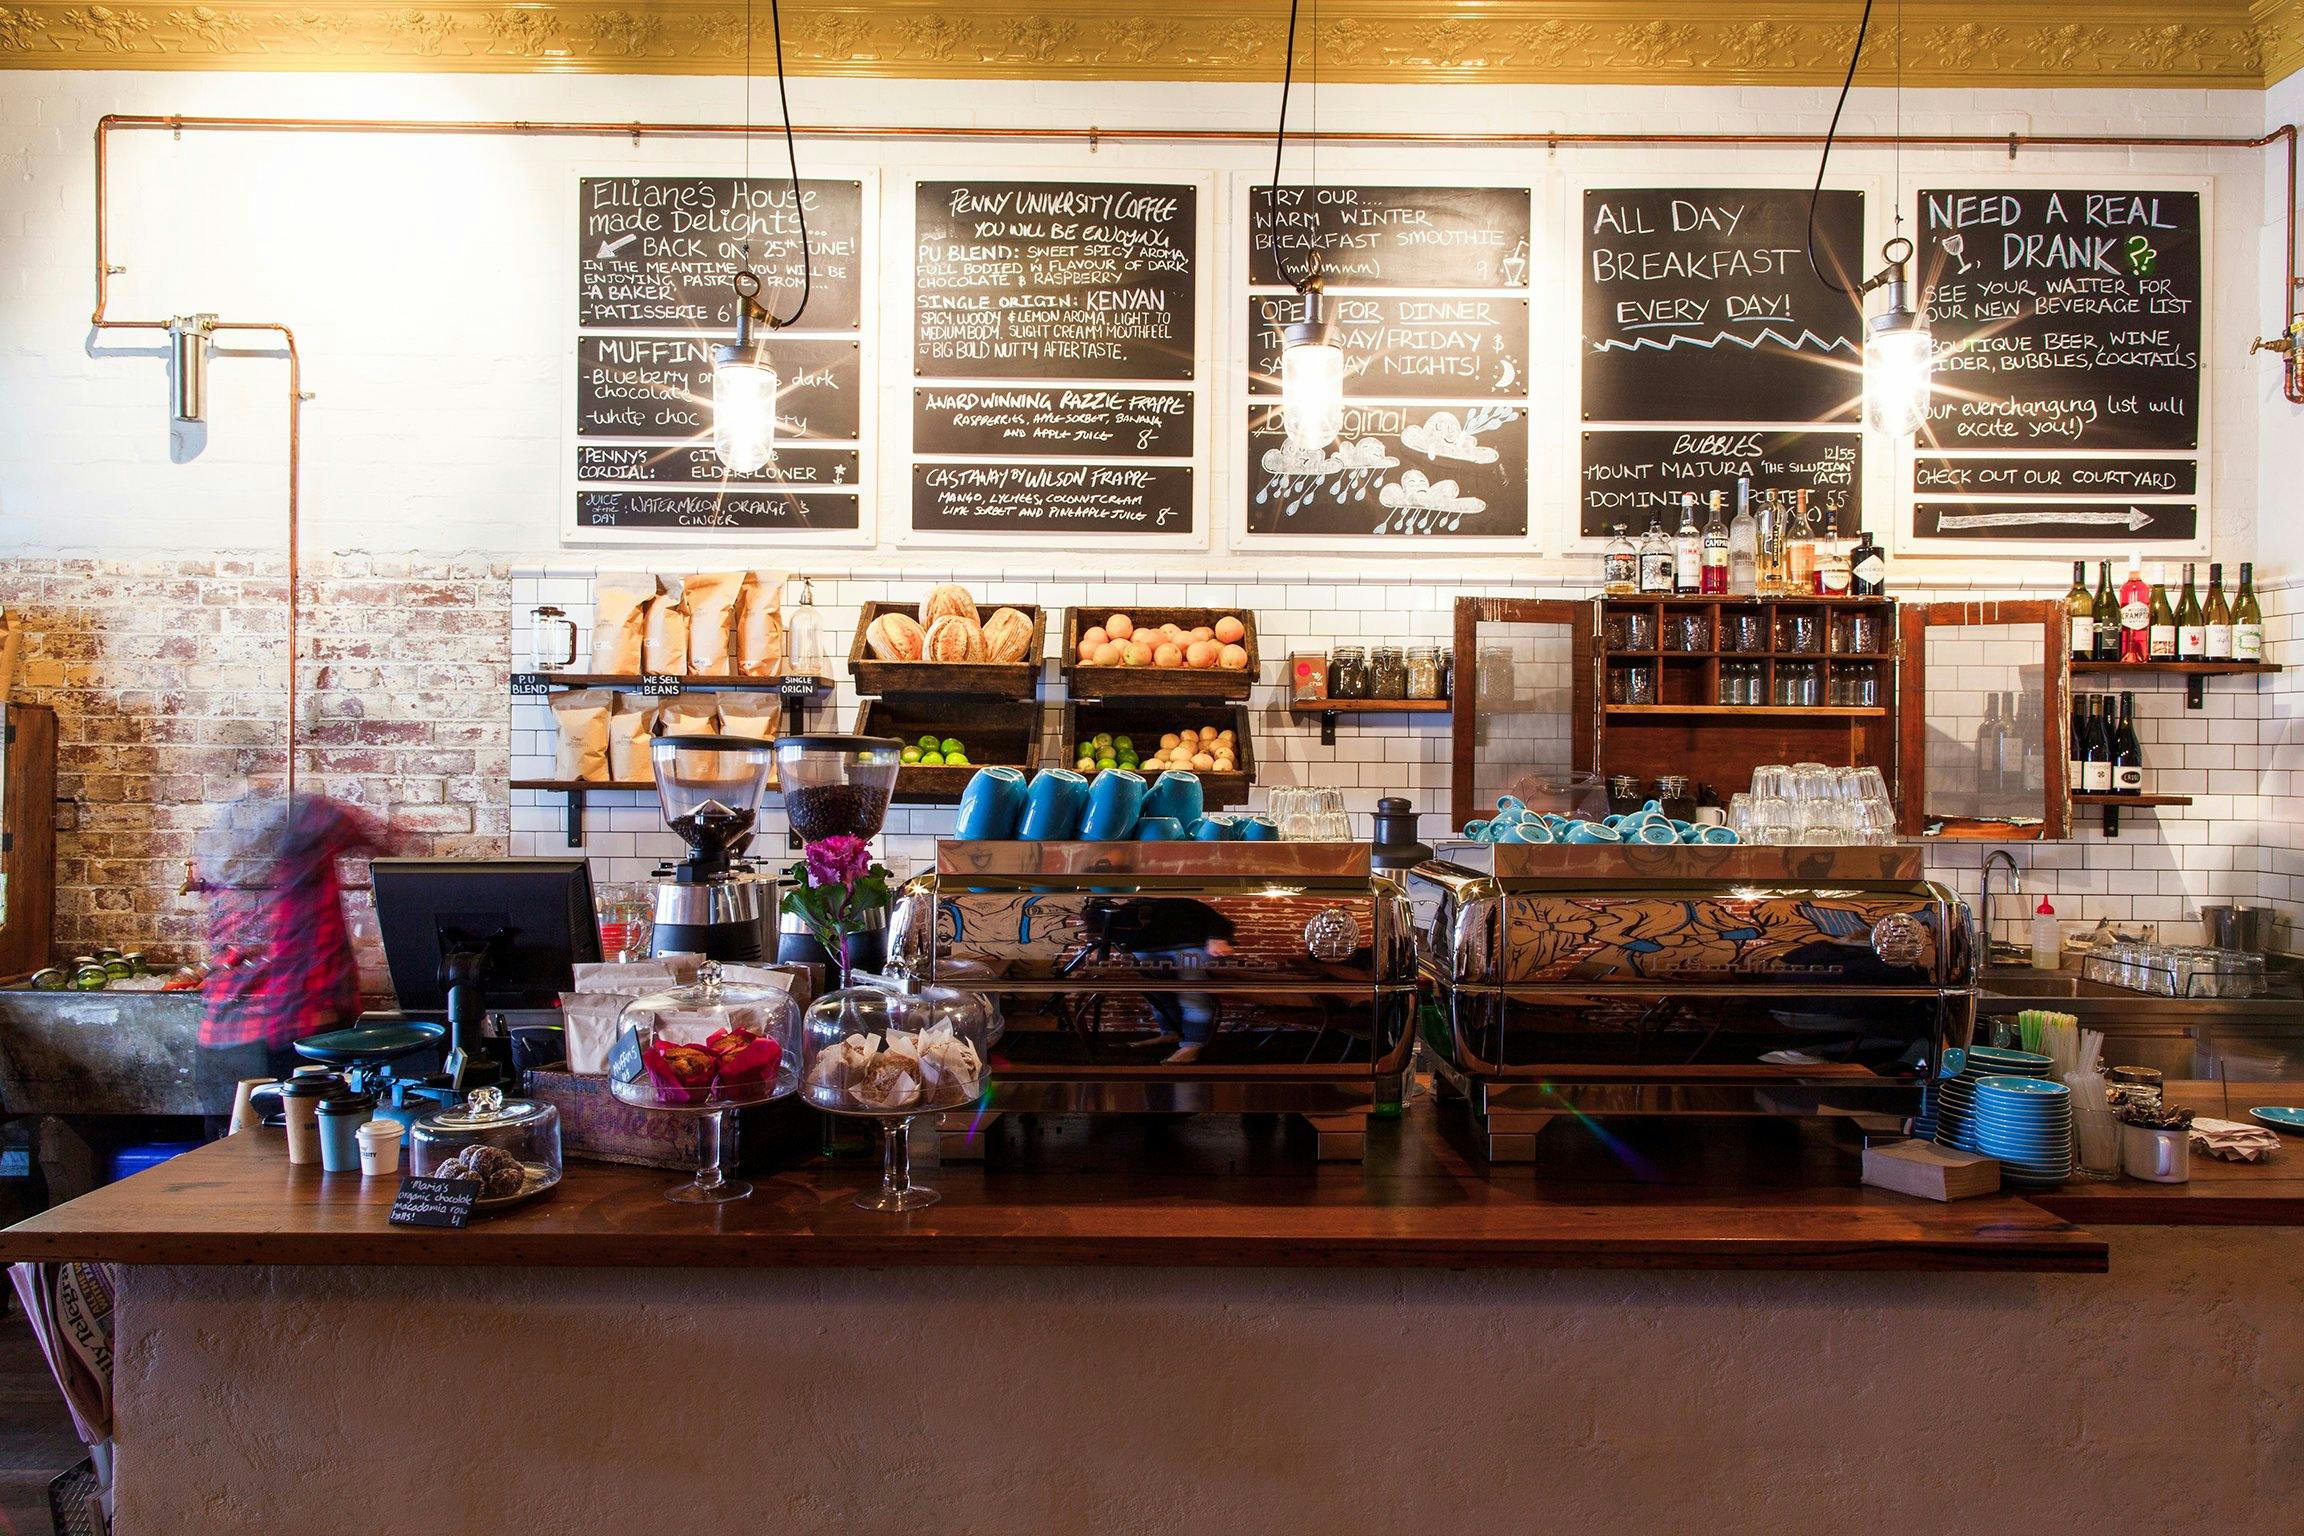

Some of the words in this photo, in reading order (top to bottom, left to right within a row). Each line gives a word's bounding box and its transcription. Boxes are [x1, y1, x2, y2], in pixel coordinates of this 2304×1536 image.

[593, 180, 715, 211] Elliane's
[732, 181, 820, 211] House
[1261, 189, 1305, 207] TRY
[950, 188, 1014, 218] PENNY
[1016, 191, 1113, 219] UNIVERSITY
[1115, 191, 1177, 223] COFFEE
[1928, 195, 2021, 229] NEED
[2046, 192, 2068, 225] A
[2086, 194, 2178, 229] REAL
[589, 210, 662, 236] made
[1255, 212, 1321, 229] WARM
[1340, 209, 1433, 227] WINTER
[1594, 203, 1655, 235] ALL
[1672, 200, 1745, 237] DAY
[974, 221, 1005, 239] YOU
[1009, 222, 1045, 238] WILL
[1050, 223, 1079, 240] BE
[1083, 226, 1170, 249] ENJOYING
[1255, 233, 1382, 250] BREAKFAST
[1396, 229, 1506, 246] SMOOTHIE
[643, 236, 708, 258] BACK
[919, 245, 941, 263] PU
[949, 245, 1020, 262] BLEND:
[1027, 246, 1078, 257] SWEET
[1084, 245, 1134, 258] SPICY
[2004, 233, 2121, 275] DRANK
[583, 259, 603, 271] IN
[609, 260, 638, 273] THE
[646, 261, 737, 274] MEANTIME
[749, 263, 777, 277] YOU
[828, 266, 847, 278] BE
[917, 263, 958, 277] FULL
[963, 262, 1023, 275] BODIED
[1049, 260, 1116, 273] FLAVOUR
[1124, 260, 1144, 271] OF
[1149, 260, 1189, 274] DARK
[1593, 249, 1801, 283] BREAKFAST
[584, 274, 675, 287] ENJOYING
[917, 275, 1010, 288] CHOCOLATE
[1034, 271, 1123, 285] RASPBERRY
[1925, 285, 1967, 303] SEE
[1977, 280, 2037, 297] YOUR
[2046, 277, 2130, 296] WAITER
[2139, 278, 2176, 298] FOR
[917, 295, 989, 310] SINGLE
[998, 293, 1079, 309] ORIGIN:
[1087, 288, 1165, 311] KENYAN
[1617, 298, 1710, 323] EVERY
[1726, 294, 1791, 318] DAY!
[958, 312, 1001, 325] WOODY
[1018, 311, 1060, 323] LEMON
[1115, 312, 1149, 324] LIGHT
[1156, 312, 1171, 324] TO
[1337, 301, 1384, 321] FOR
[1399, 301, 1500, 325] DINNER
[1926, 304, 1968, 323] OUR
[1974, 300, 2020, 318] NEW
[2035, 297, 2140, 315] BEVERAGE
[2150, 299, 2192, 314] LIST
[921, 326, 968, 340] MEDIUM
[1009, 325, 1050, 339] SLIGHT
[1053, 325, 1103, 339] CREAMY
[1106, 325, 1172, 339] MOUTHFEEL
[933, 342, 952, 359] BIG
[956, 342, 989, 359] BOLD
[994, 343, 1038, 359] NUTTY
[1043, 342, 1127, 361] AFTERTASTE.
[1930, 335, 2032, 355] BOUTIQUE
[2044, 332, 2105, 354] BEER,
[2109, 330, 2180, 353] WINE,
[1384, 355, 1480, 380] NIGHTS!
[2001, 353, 2093, 372] BUBBLES,
[2096, 349, 2197, 370] COCKTAILS
[792, 368, 839, 389] dark
[594, 386, 693, 402] chocolate
[1059, 392, 1125, 411] RAZZIE
[1128, 395, 1185, 415] FRAPPE
[1962, 395, 2097, 423] everchanging
[2108, 395, 2138, 414] list
[2149, 398, 2185, 416] will
[655, 409, 700, 425] choc
[1003, 428, 1026, 438] AND
[1033, 429, 1071, 438] APPLE
[1073, 430, 1113, 441] JUICE
[1958, 420, 2019, 437] excite
[2029, 416, 2083, 440] you!)
[1672, 432, 1763, 457] BUBBLES
[1824, 445, 1856, 461] 12/55
[585, 449, 647, 464] PENNY'S
[578, 465, 655, 480] CORDIAL:
[925, 468, 1005, 488] CASTAWAY
[1010, 468, 1025, 480] BY
[1025, 466, 1087, 488] WILSON
[1091, 467, 1156, 488] FRAPPE
[1661, 462, 1754, 480] MAJURA
[1812, 472, 1852, 485] (ACT)
[1917, 469, 1972, 485] CHECK
[1979, 469, 2018, 483] OUT
[2024, 470, 2061, 485] OUR
[2072, 470, 2176, 490] COURTYARD
[585, 493, 622, 506] JUICE
[938, 492, 986, 505] MANGO,
[1045, 493, 1100, 504] COCONUT
[1099, 495, 1142, 505] CREAM
[728, 501, 789, 515] ORANGE
[942, 505, 970, 516] LIME
[973, 506, 1017, 516] SORBET
[1018, 507, 1043, 518] AND
[1049, 507, 1111, 519] PINEAPPLE
[1111, 508, 1147, 521] JUICE
[592, 514, 615, 525] DAY
[679, 515, 739, 526] GINGER
[643, 676, 658, 684] WE
[659, 676, 680, 684] SELL
[784, 676, 812, 684] SINGLE
[512, 684, 548, 695] BLEND
[643, 685, 680, 695] BEANS
[781, 685, 814, 694] ORIGIN
[398, 1191, 431, 1204] organic
[393, 1201, 447, 1214] macadamia
[449, 1206, 468, 1215] raw
